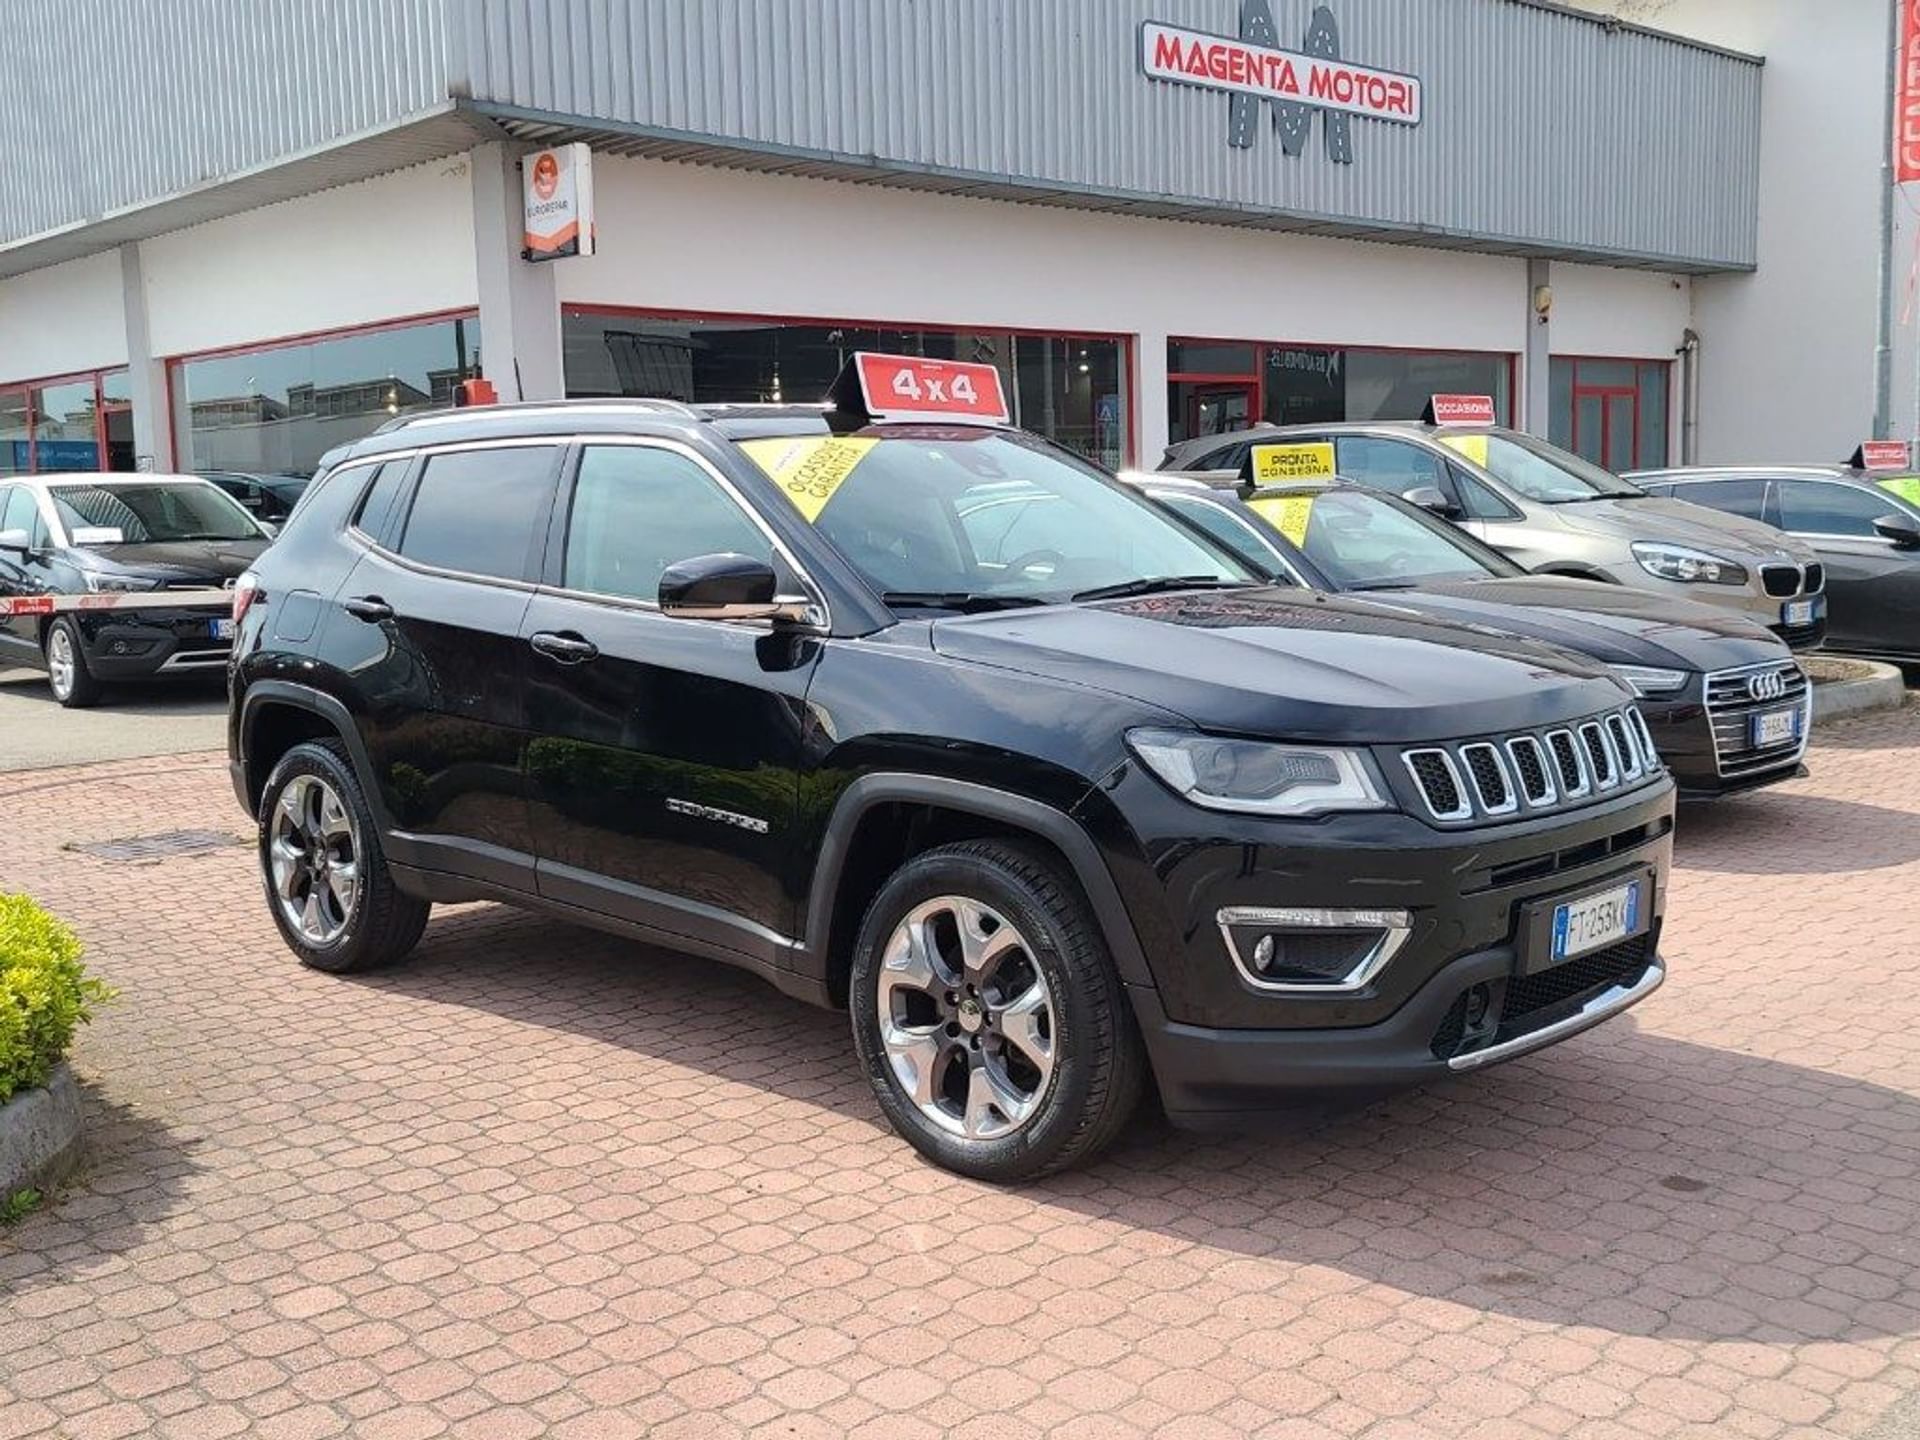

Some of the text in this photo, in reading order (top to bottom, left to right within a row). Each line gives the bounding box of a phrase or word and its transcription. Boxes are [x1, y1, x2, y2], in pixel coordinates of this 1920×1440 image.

[1154, 33, 1414, 115] MAGENTA MOTORI
[787, 440, 845, 493] OCCASIONE
[1260, 465, 1330, 478] CONSEGNA
[1271, 453, 1319, 466] PRONTA
